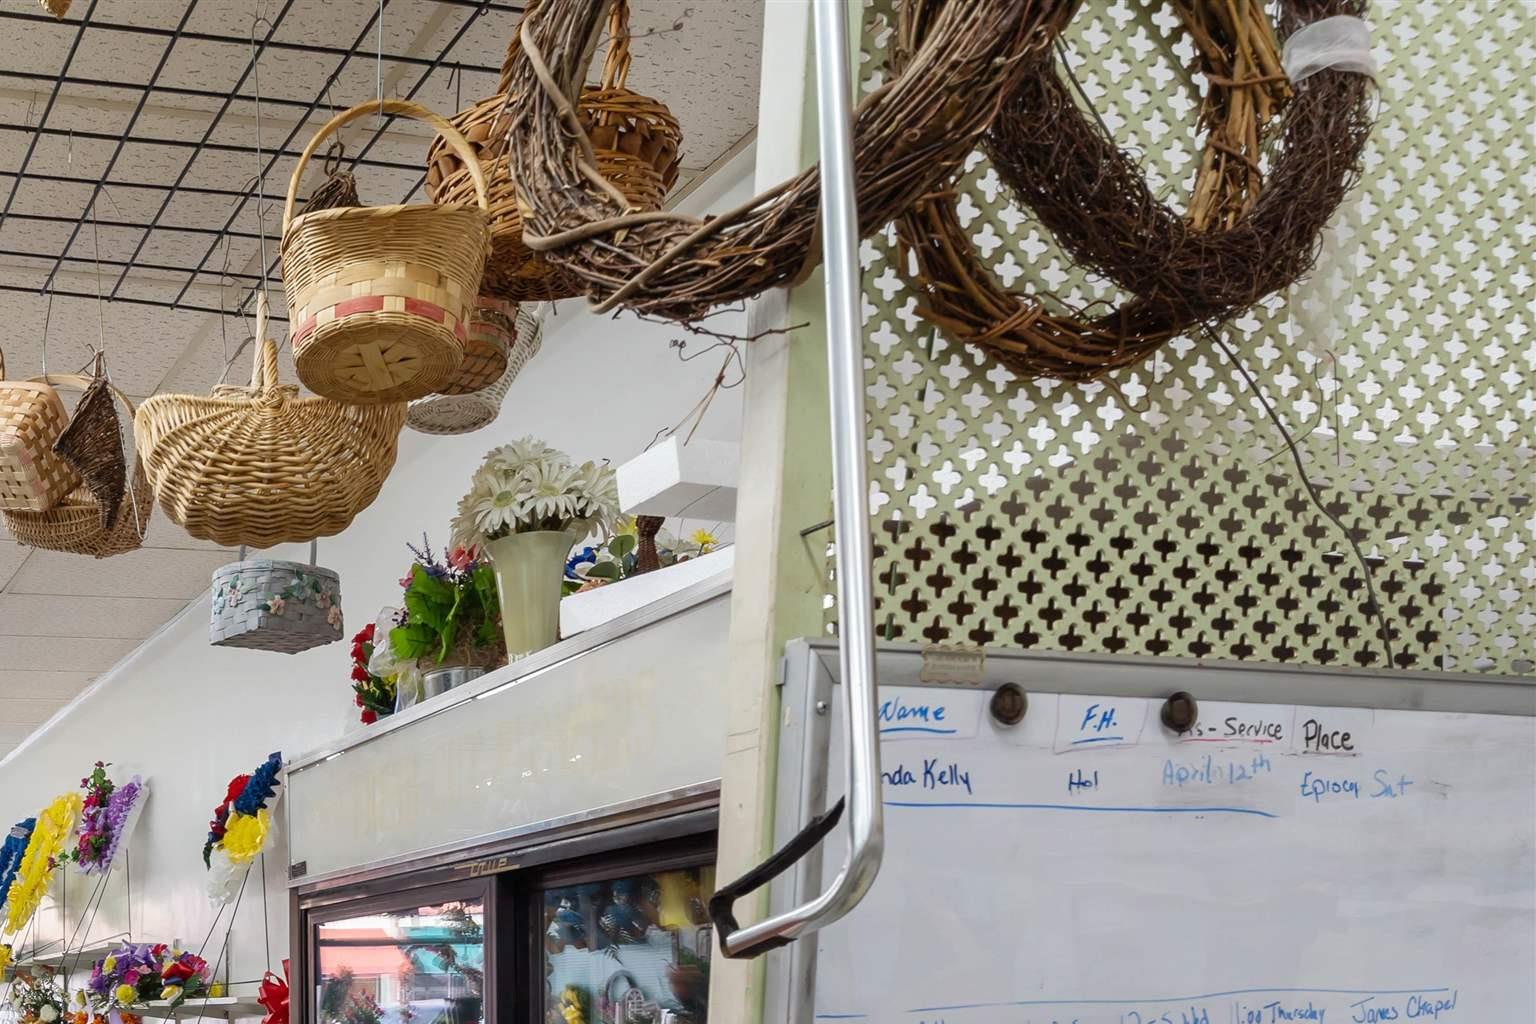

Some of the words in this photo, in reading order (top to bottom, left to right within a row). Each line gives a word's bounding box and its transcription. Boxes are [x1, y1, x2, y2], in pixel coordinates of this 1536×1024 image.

[879, 698, 946, 722] Name
[1080, 703, 1118, 732] F.H.
[1223, 716, 1283, 740] Service
[1302, 708, 1355, 751] Place
[923, 758, 973, 794] Kelly
[1163, 755, 1213, 786] April
